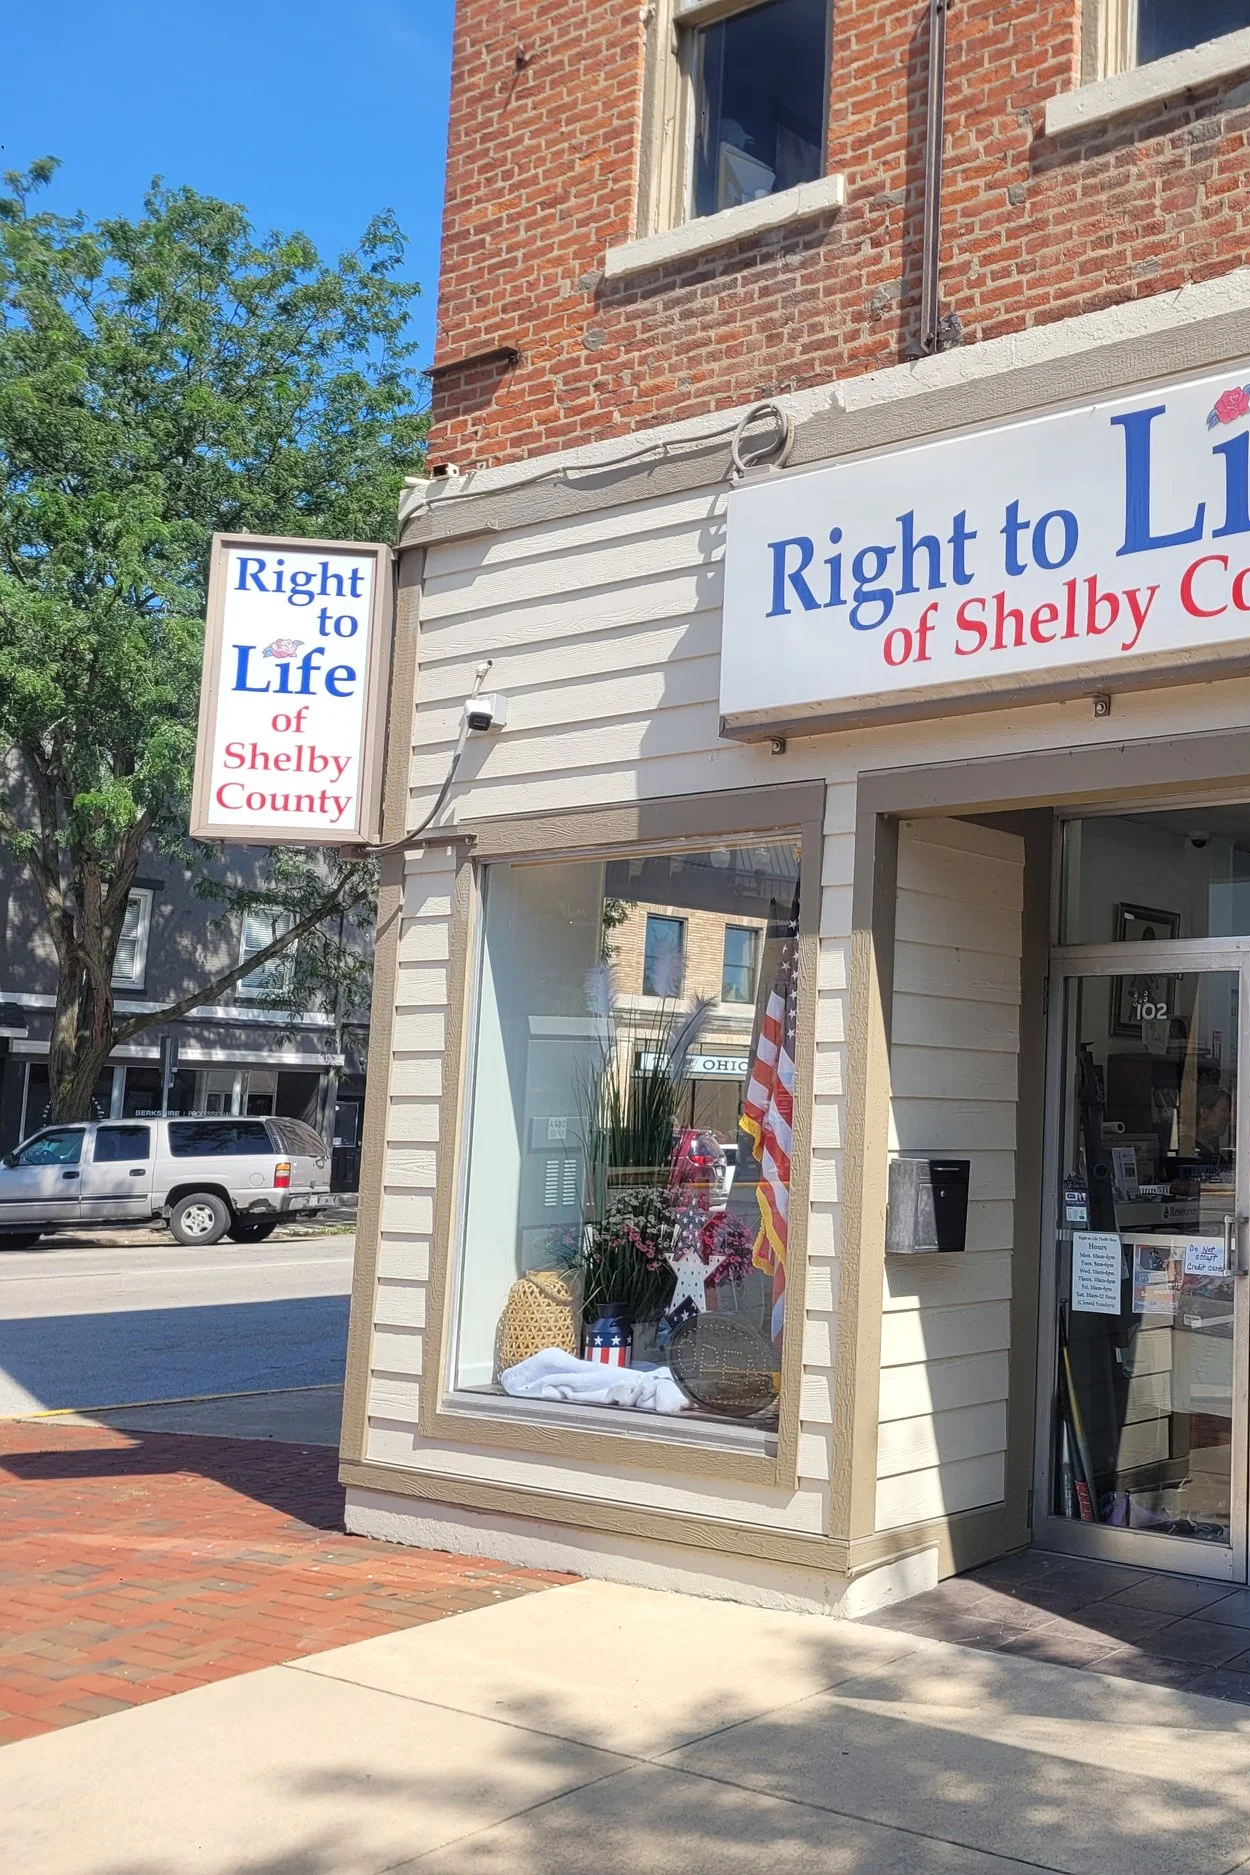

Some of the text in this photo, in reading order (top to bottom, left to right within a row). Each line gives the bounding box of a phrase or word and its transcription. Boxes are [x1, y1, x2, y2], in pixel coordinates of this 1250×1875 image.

[234, 556, 364, 607] Right
[764, 508, 977, 631] Right
[1000, 499, 1079, 577] to
[316, 606, 359, 638] to
[882, 603, 936, 667] of
[954, 574, 1160, 652] Shelby
[231, 644, 357, 698] Life
[271, 705, 310, 734] of
[223, 742, 352, 783] Shelby
[215, 782, 352, 823] County
[1136, 1002, 1167, 1020] 102
[135, 1109, 180, 1117] BERKSIRE
[1189, 1244, 1198, 1252] Do
